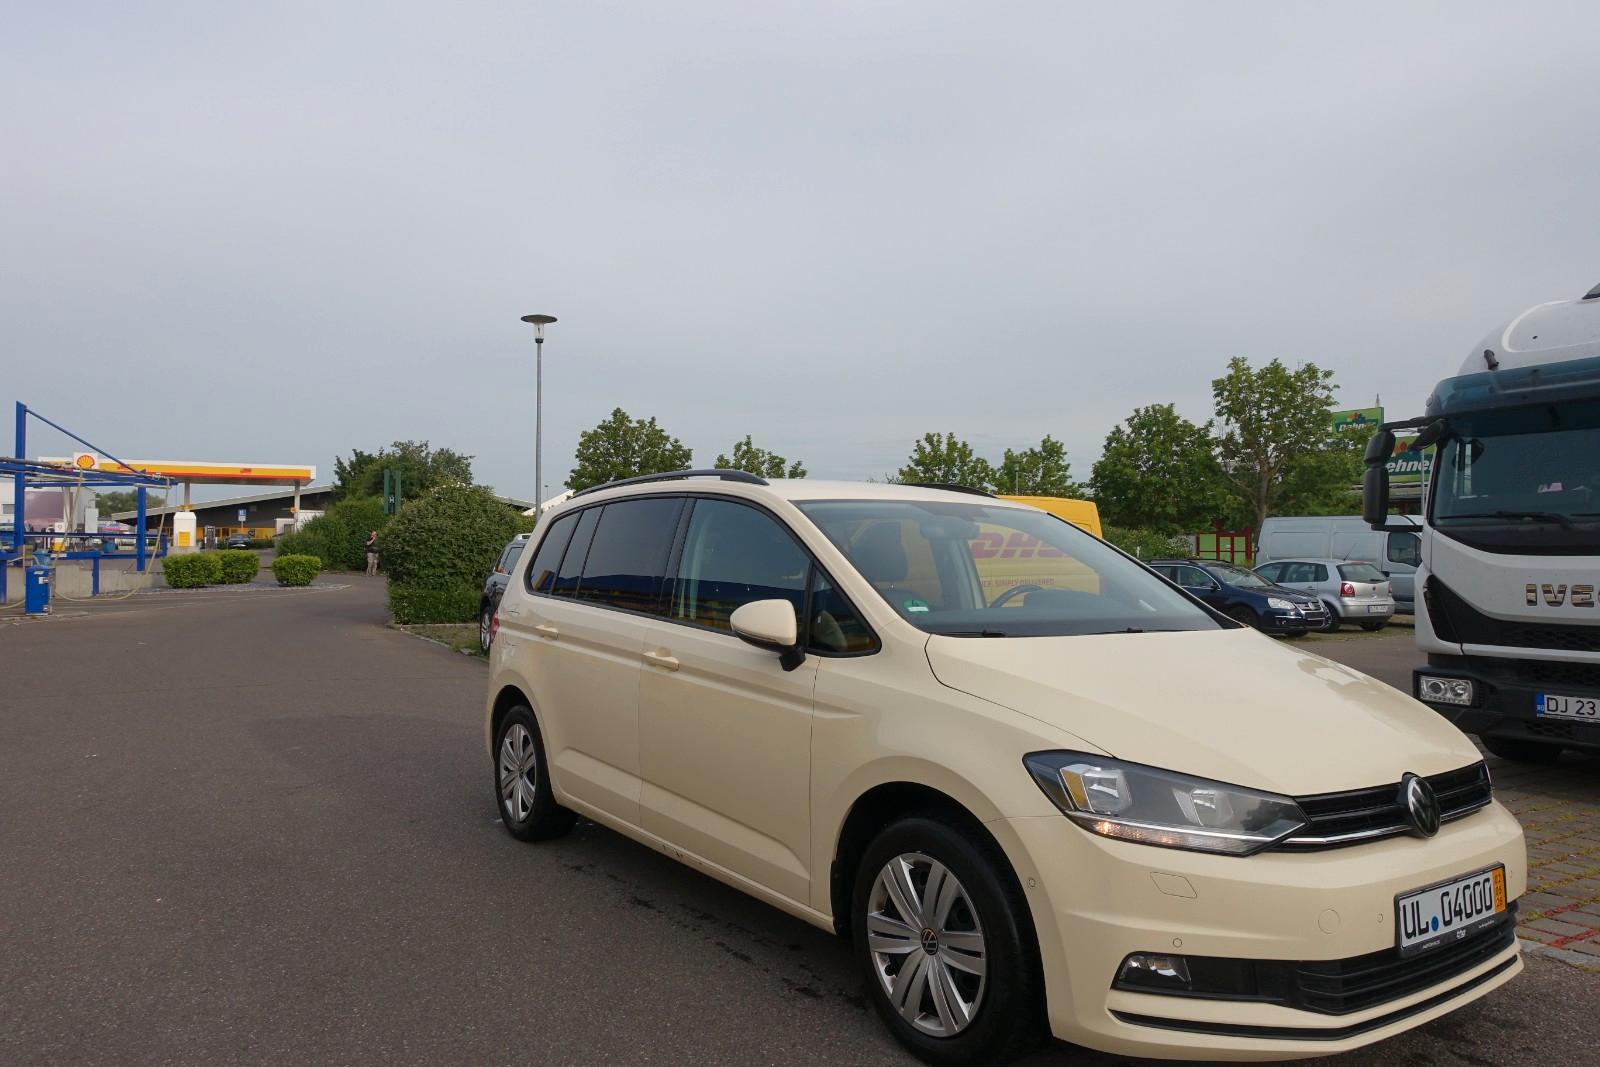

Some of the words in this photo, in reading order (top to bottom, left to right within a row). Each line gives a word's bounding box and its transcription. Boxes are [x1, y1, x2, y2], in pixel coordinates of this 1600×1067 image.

[1386, 459, 1434, 473] ehne
[1525, 583, 1600, 608] IVE
[1546, 697, 1568, 713] DJ
[1575, 700, 1596, 716] 23
[1402, 900, 1430, 939] UL
